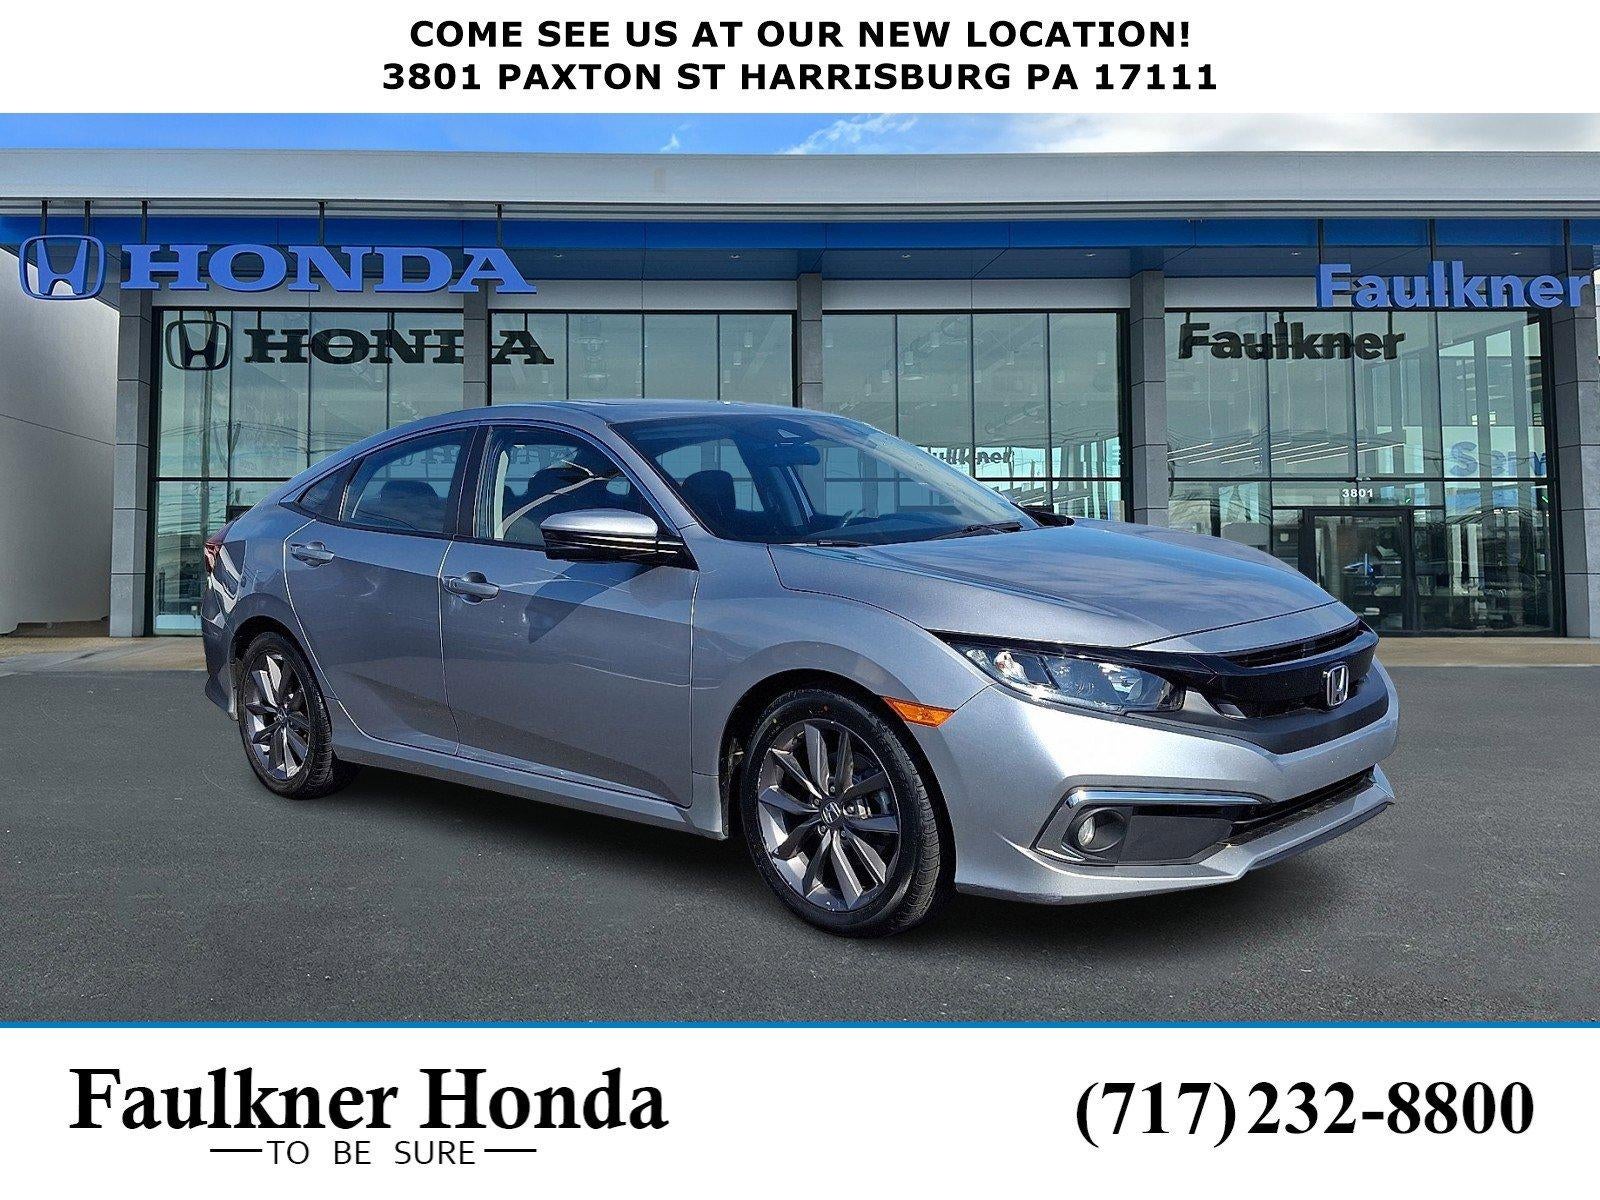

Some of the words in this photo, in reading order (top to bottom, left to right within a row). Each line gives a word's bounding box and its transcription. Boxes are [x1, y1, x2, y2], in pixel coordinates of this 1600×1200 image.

[120, 243, 537, 294] HONDA
[1316, 260, 1591, 308] Faulkner
[1178, 322, 1405, 360] Faulkner
[1342, 488, 1374, 499] 3801
